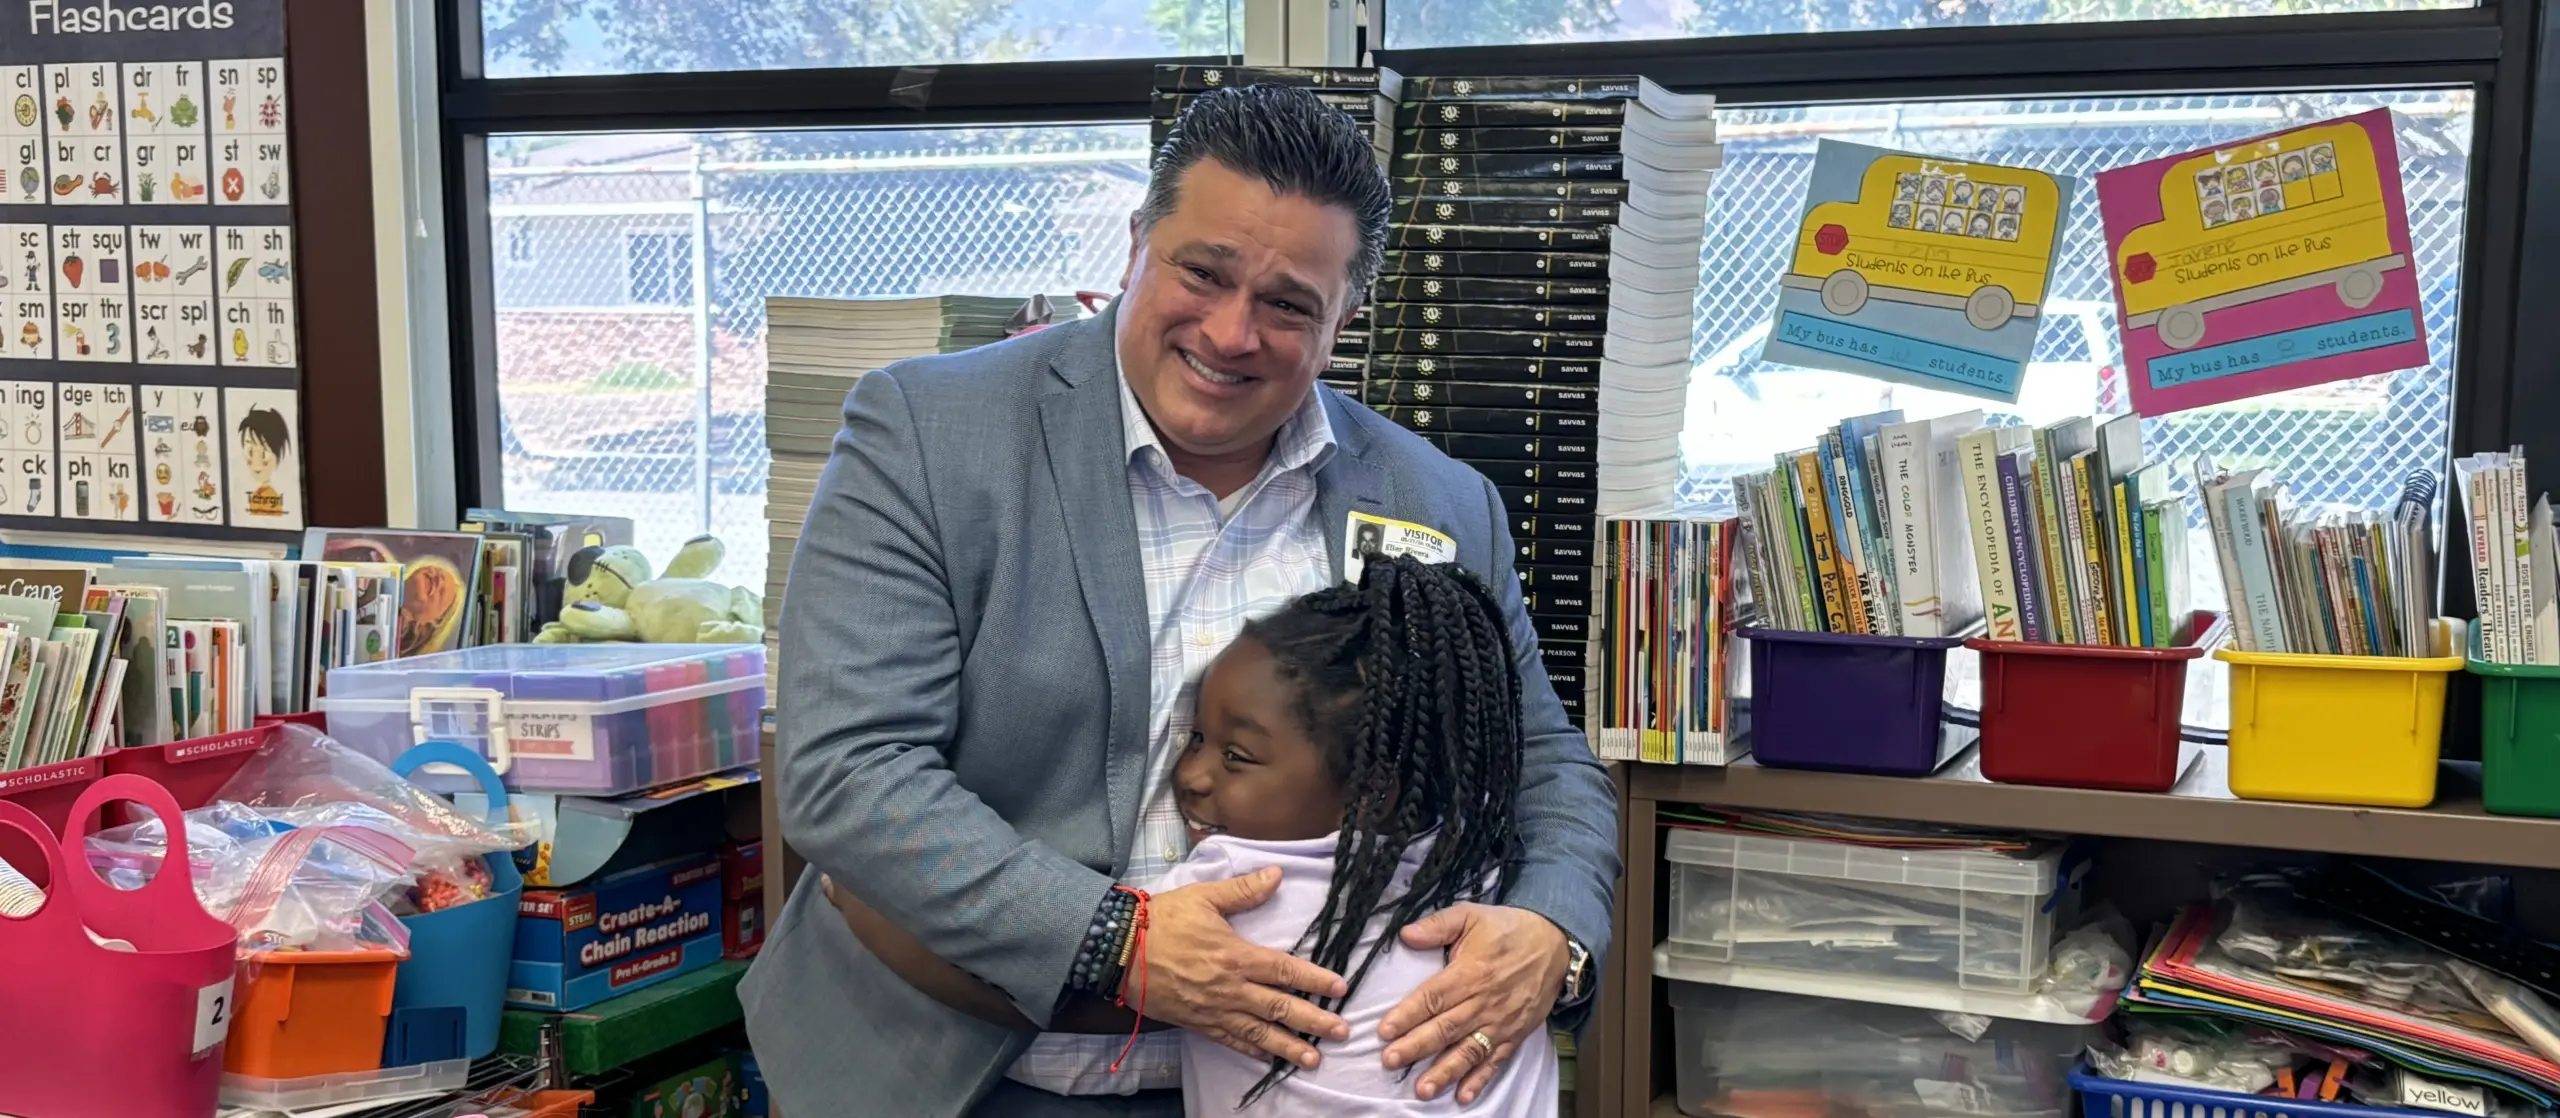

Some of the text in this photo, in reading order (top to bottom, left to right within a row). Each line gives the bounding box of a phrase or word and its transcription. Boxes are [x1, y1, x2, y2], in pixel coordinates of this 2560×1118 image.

[30, 0, 234, 34] Flashcards
[16, 67, 32, 88] cl
[54, 67, 70, 93] pl
[92, 66, 104, 87] sl
[134, 66, 152, 88] dr
[176, 65, 189, 85] fr
[219, 68, 238, 84] sn
[258, 66, 277, 88] sp
[20, 140, 36, 164] gl
[59, 142, 75, 161] br
[94, 144, 110, 161] cr
[138, 144, 155, 166] gr
[178, 143, 196, 166] pr
[224, 140, 239, 160] st
[259, 144, 281, 160] sw
[20, 231, 39, 247] sc
[62, 228, 80, 249] str
[92, 232, 122, 254] squ
[139, 229, 160, 248] tw
[180, 232, 202, 248] wr
[227, 229, 243, 249] th
[264, 229, 282, 250] sh
[1846, 253, 1992, 285] Students On the Bus
[2175, 236, 2332, 284] Students On the Bus
[20, 302, 44, 318] sm
[62, 301, 88, 322] spr
[100, 299, 122, 319] thr
[141, 304, 167, 320] scr
[181, 301, 208, 322] spl
[228, 302, 250, 323] ch
[268, 303, 284, 324] th
[1786, 324, 1810, 341] My
[1816, 331, 1844, 346] bus
[1849, 338, 1878, 355] has
[1929, 357, 2007, 384] students.
[2158, 324, 2406, 383] My bus has students.
[16, 384, 44, 408] ing
[64, 386, 92, 405] dge
[104, 387, 125, 404] tch
[154, 390, 163, 407] y
[194, 391, 203, 408] y
[22, 455, 47, 474] ck
[69, 456, 91, 478] ph
[108, 458, 129, 478] kn
[1897, 458, 1909, 480] THE
[1838, 475, 1852, 518] RINGGOLD
[1900, 484, 1913, 517] COLOR
[1971, 442, 2003, 596] THE ENCYCLOPEDIA OF
[1404, 528, 1443, 548] VISITOR
[2476, 525, 2486, 562] LEVELED
[1902, 523, 1919, 575] MONSTER
[2004, 474, 2020, 534] CHILDREN'S
[2013, 535, 2032, 610] ENCYCLOPEDIA
[2025, 611, 2035, 625] OF
[9, 578, 63, 601] Crane
[1822, 572, 1839, 603] Pete
[1857, 572, 1870, 596] TAR
[2478, 567, 2492, 616] Readers'
[1852, 600, 1859, 610] IN
[2255, 593, 2268, 615] THE
[2520, 563, 2528, 586] ROSIE
[2525, 624, 2534, 662] ENGINEER
[1854, 611, 1862, 624] THE
[521, 723, 560, 738] STRIPS
[187, 736, 255, 756] SCHOLASTIC
[9, 766, 86, 788] SCHOLASTIC
[568, 914, 592, 925] STEM
[599, 894, 681, 932] Create-A-
[580, 912, 709, 964] Chain Reaction
[616, 968, 630, 979] Pre
[632, 955, 669, 974] K-Grade
[211, 996, 224, 1024] 2
[2409, 1088, 2480, 1110] yellow
